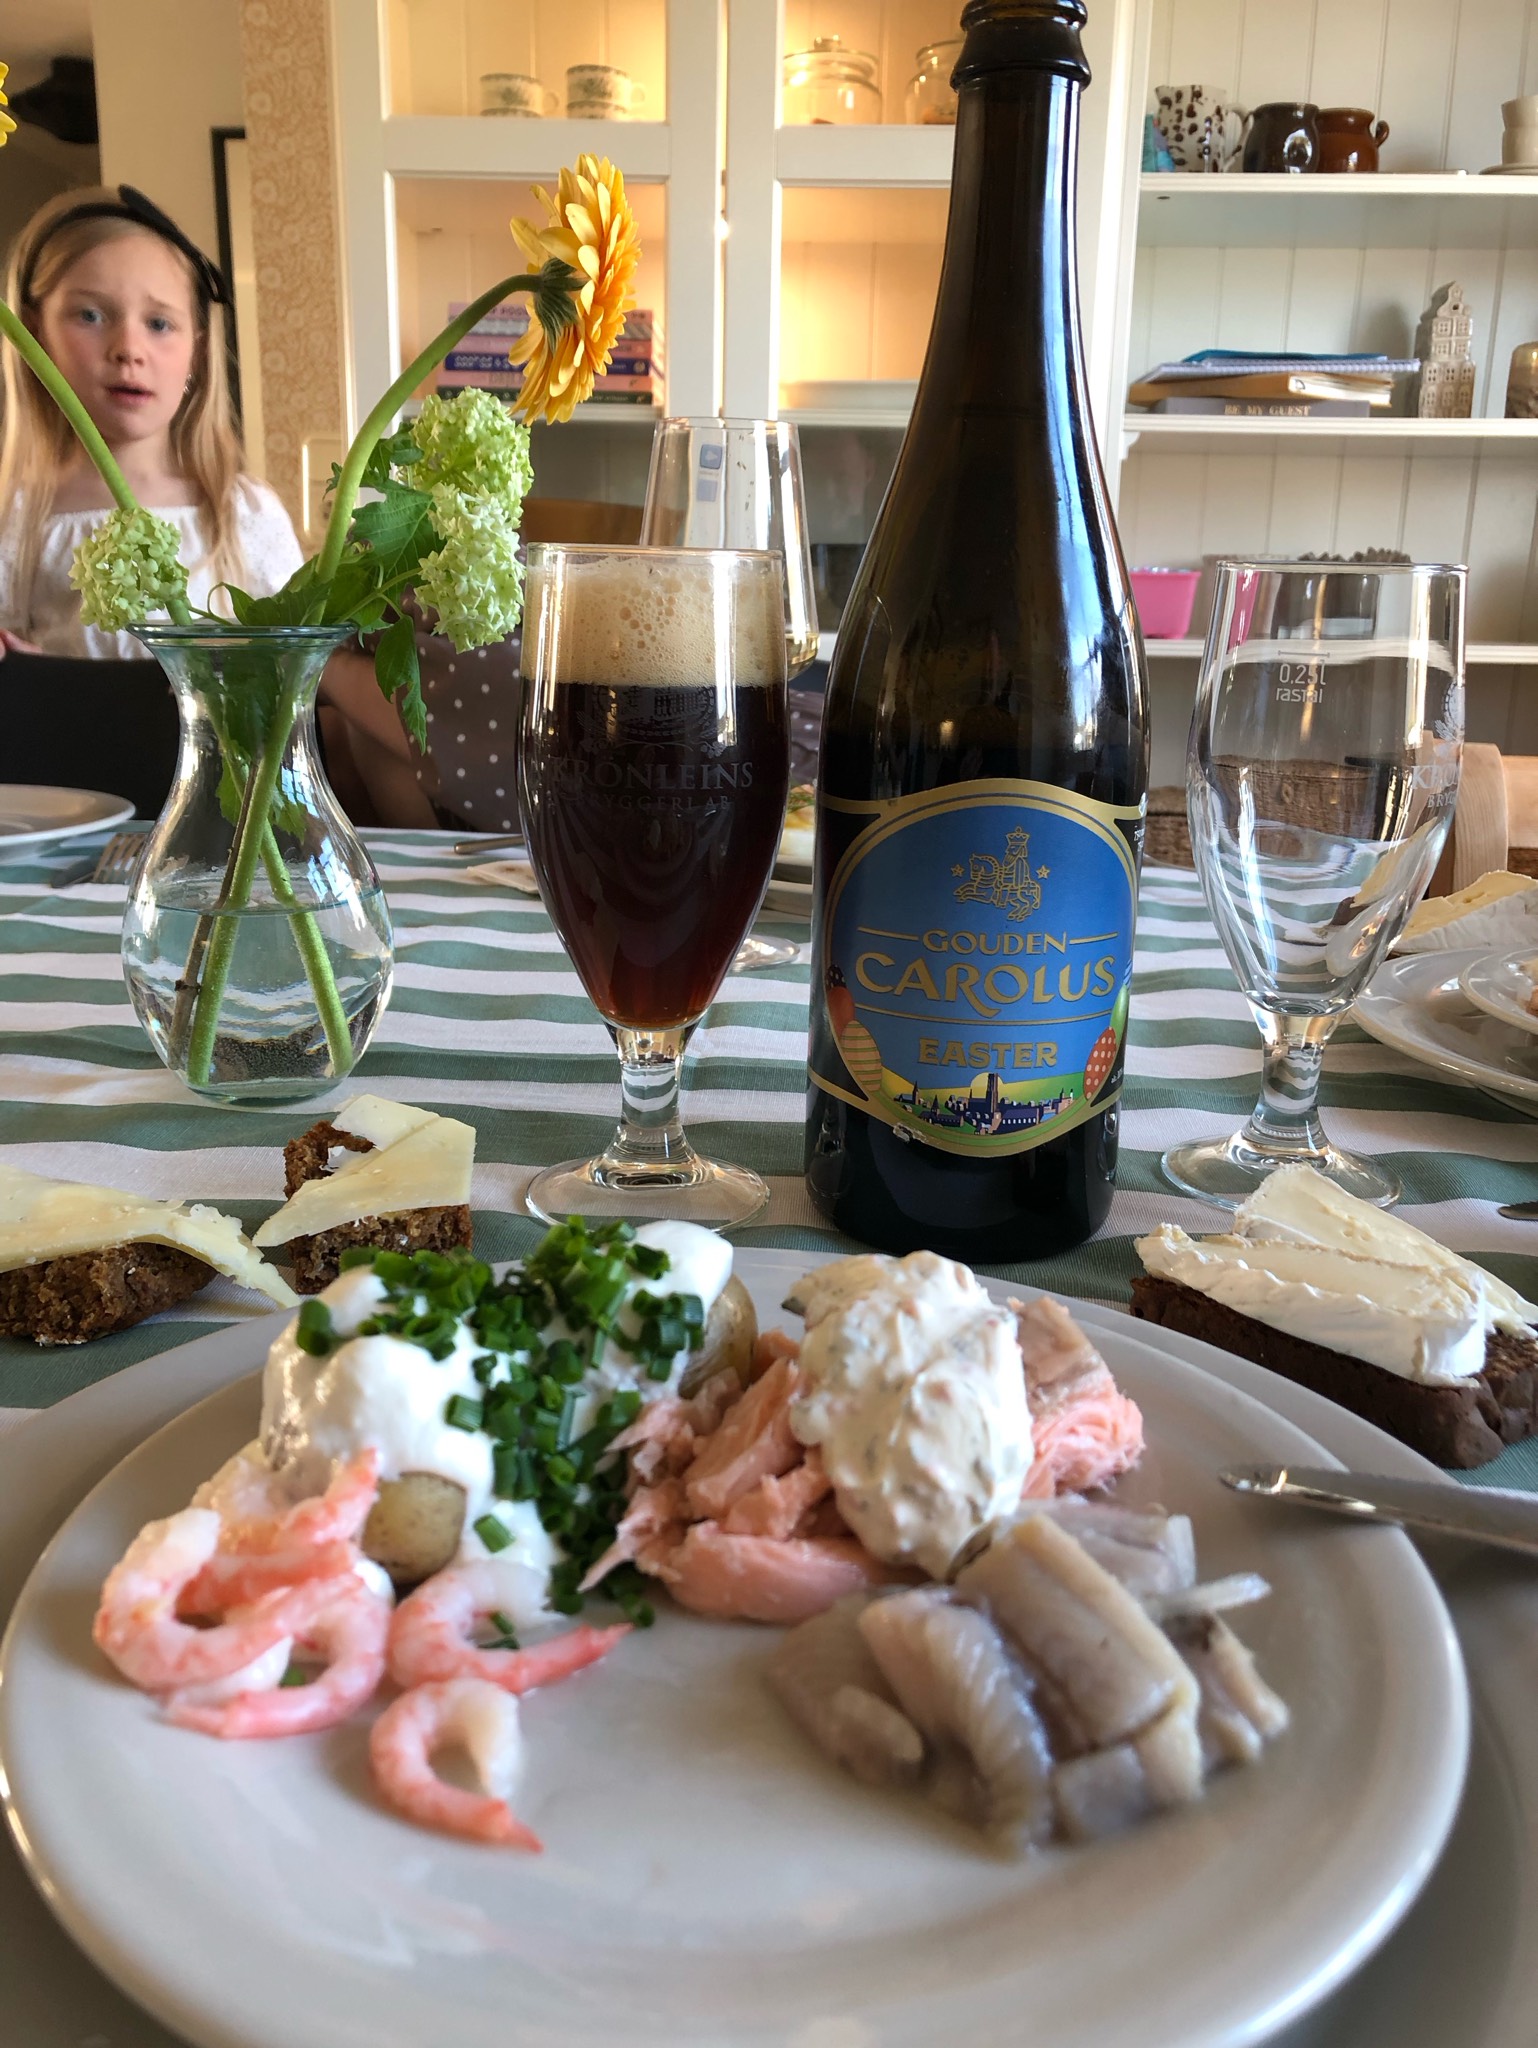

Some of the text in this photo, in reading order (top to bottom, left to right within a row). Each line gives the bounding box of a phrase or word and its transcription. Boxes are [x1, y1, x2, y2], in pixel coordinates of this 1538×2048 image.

[1269, 404, 1311, 416] GUEST
[705, 795, 729, 810] AB
[921, 929, 1067, 955] GOUDEN
[855, 952, 1115, 1019] CAROLUS
[917, 1036, 1059, 1069] EASTER
